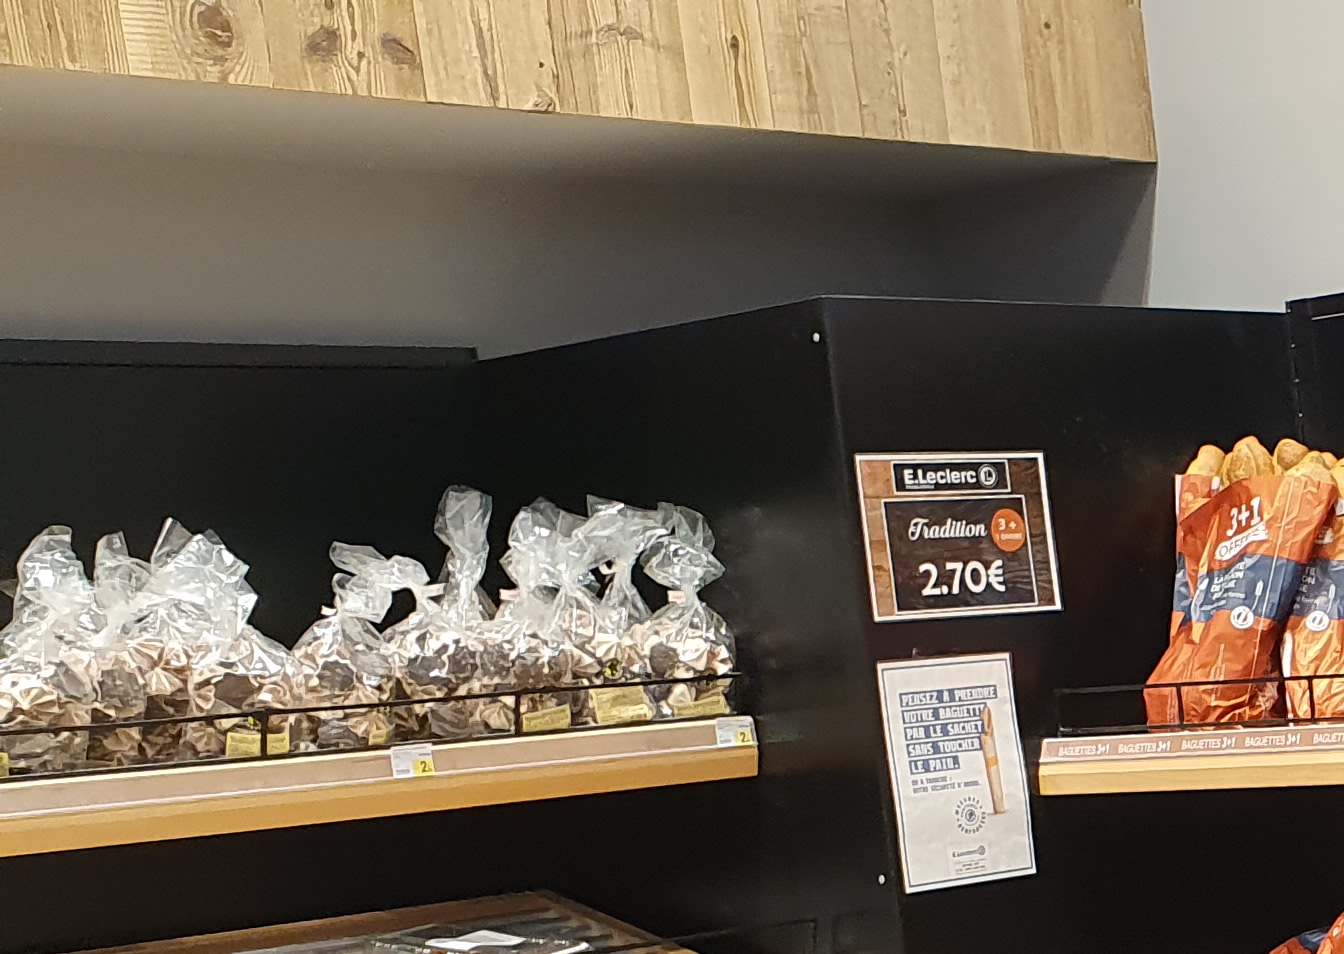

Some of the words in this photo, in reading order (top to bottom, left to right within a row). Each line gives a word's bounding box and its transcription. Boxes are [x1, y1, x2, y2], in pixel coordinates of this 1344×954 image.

[903, 468, 977, 486] E.Leclerc
[908, 517, 988, 542] Tradition
[918, 559, 1006, 597] 2.70€
[901, 691, 939, 706] PENSEZ
[954, 687, 996, 701] PRENDRE
[903, 709, 935, 723] VOTRE
[938, 704, 984, 720] BAGUETT
[905, 727, 926, 740] PAR
[929, 725, 943, 737] LE
[946, 721, 983, 736] SACHET
[908, 743, 934, 757] SANS
[937, 738, 981, 753] TOUCHER
[910, 761, 926, 774] LE
